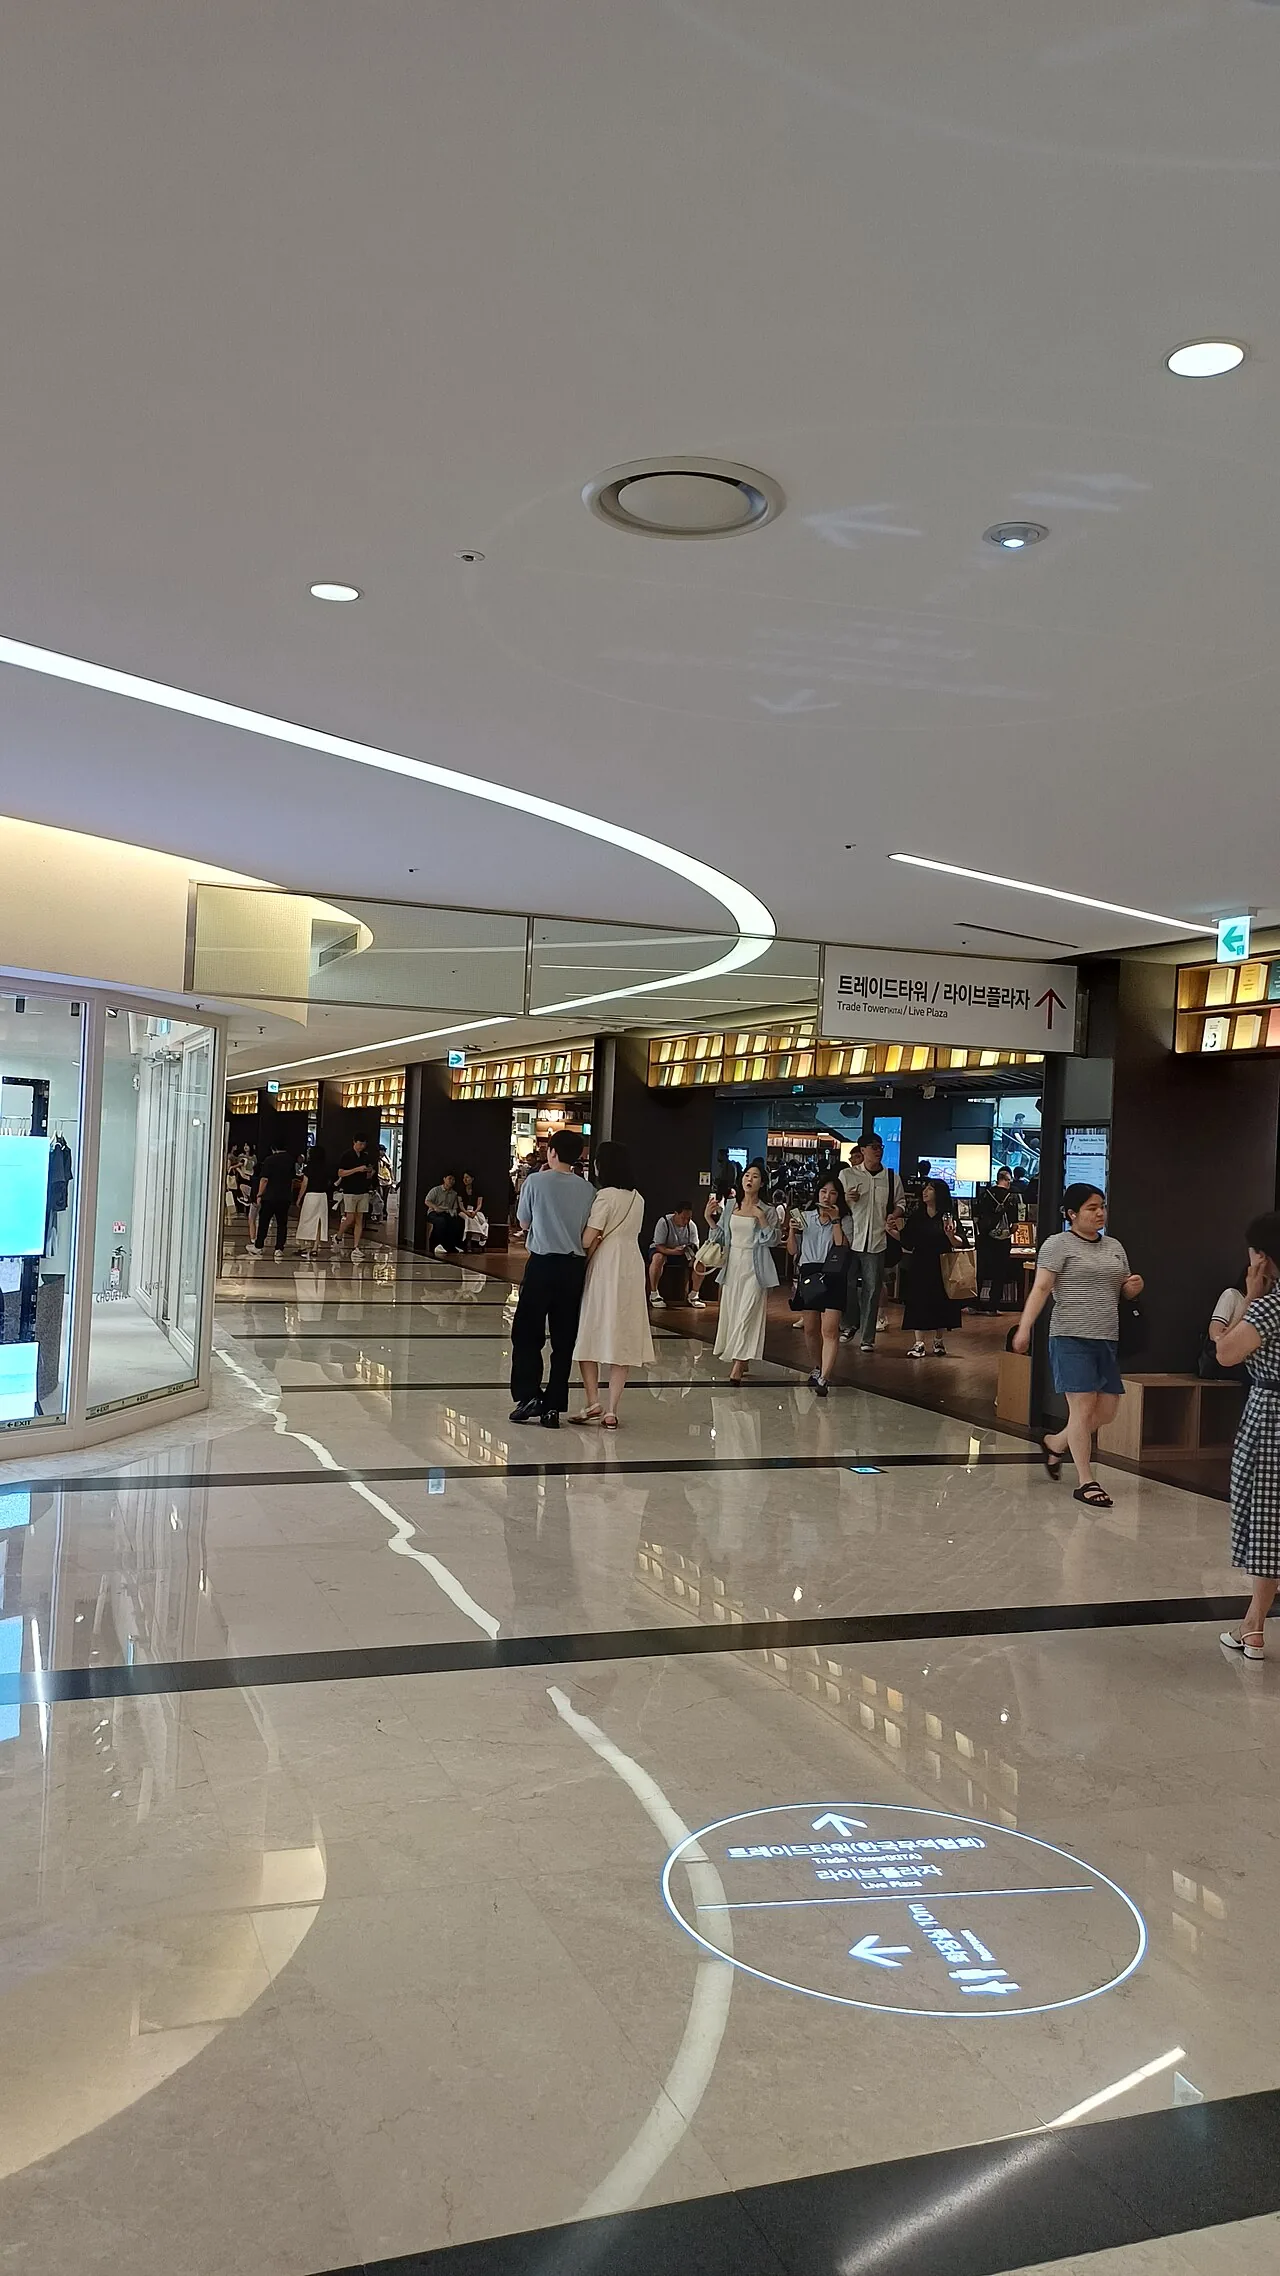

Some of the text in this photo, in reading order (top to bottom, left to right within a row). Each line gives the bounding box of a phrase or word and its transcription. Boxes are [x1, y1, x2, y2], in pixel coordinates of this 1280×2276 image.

[838, 975, 1031, 1011] 트레이드타워 / 라이브플라자
[837, 1001, 861, 1012] Trade
[909, 1006, 925, 1017] Live
[926, 1007, 948, 1018] Plaza
[816, 1865, 943, 1881] 라이브플라자
[908, 1903, 940, 1927] 10m
